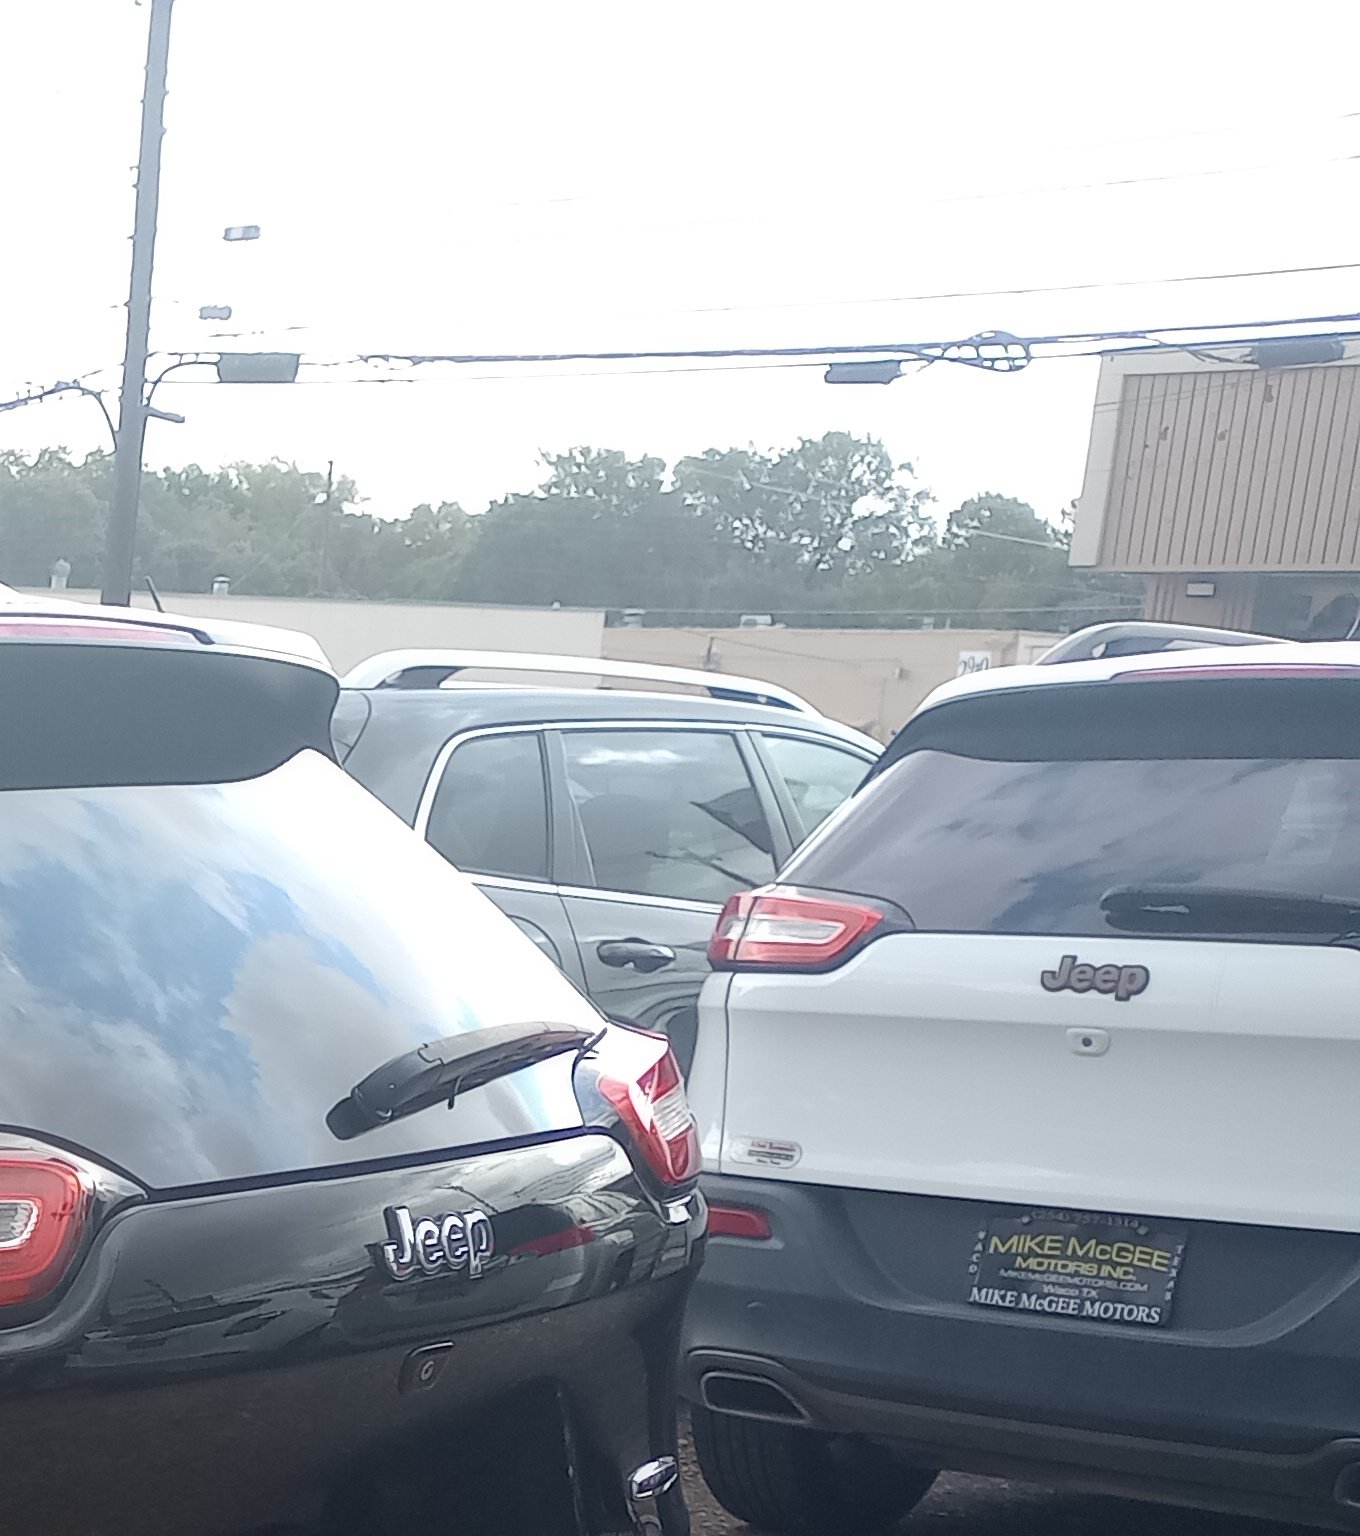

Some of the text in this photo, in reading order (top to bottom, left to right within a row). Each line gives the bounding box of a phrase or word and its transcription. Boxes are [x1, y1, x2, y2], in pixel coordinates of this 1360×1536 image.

[1041, 955, 1150, 1001] Jeep
[381, 1205, 494, 1280] Jeep
[988, 1234, 1172, 1272] MIKE McGEE
[1015, 1256, 1137, 1282] MOTORS INC.
[969, 1286, 1161, 1324] MIKE McGEE MOTORS
[1042, 1284, 1099, 1300] Waco TX
